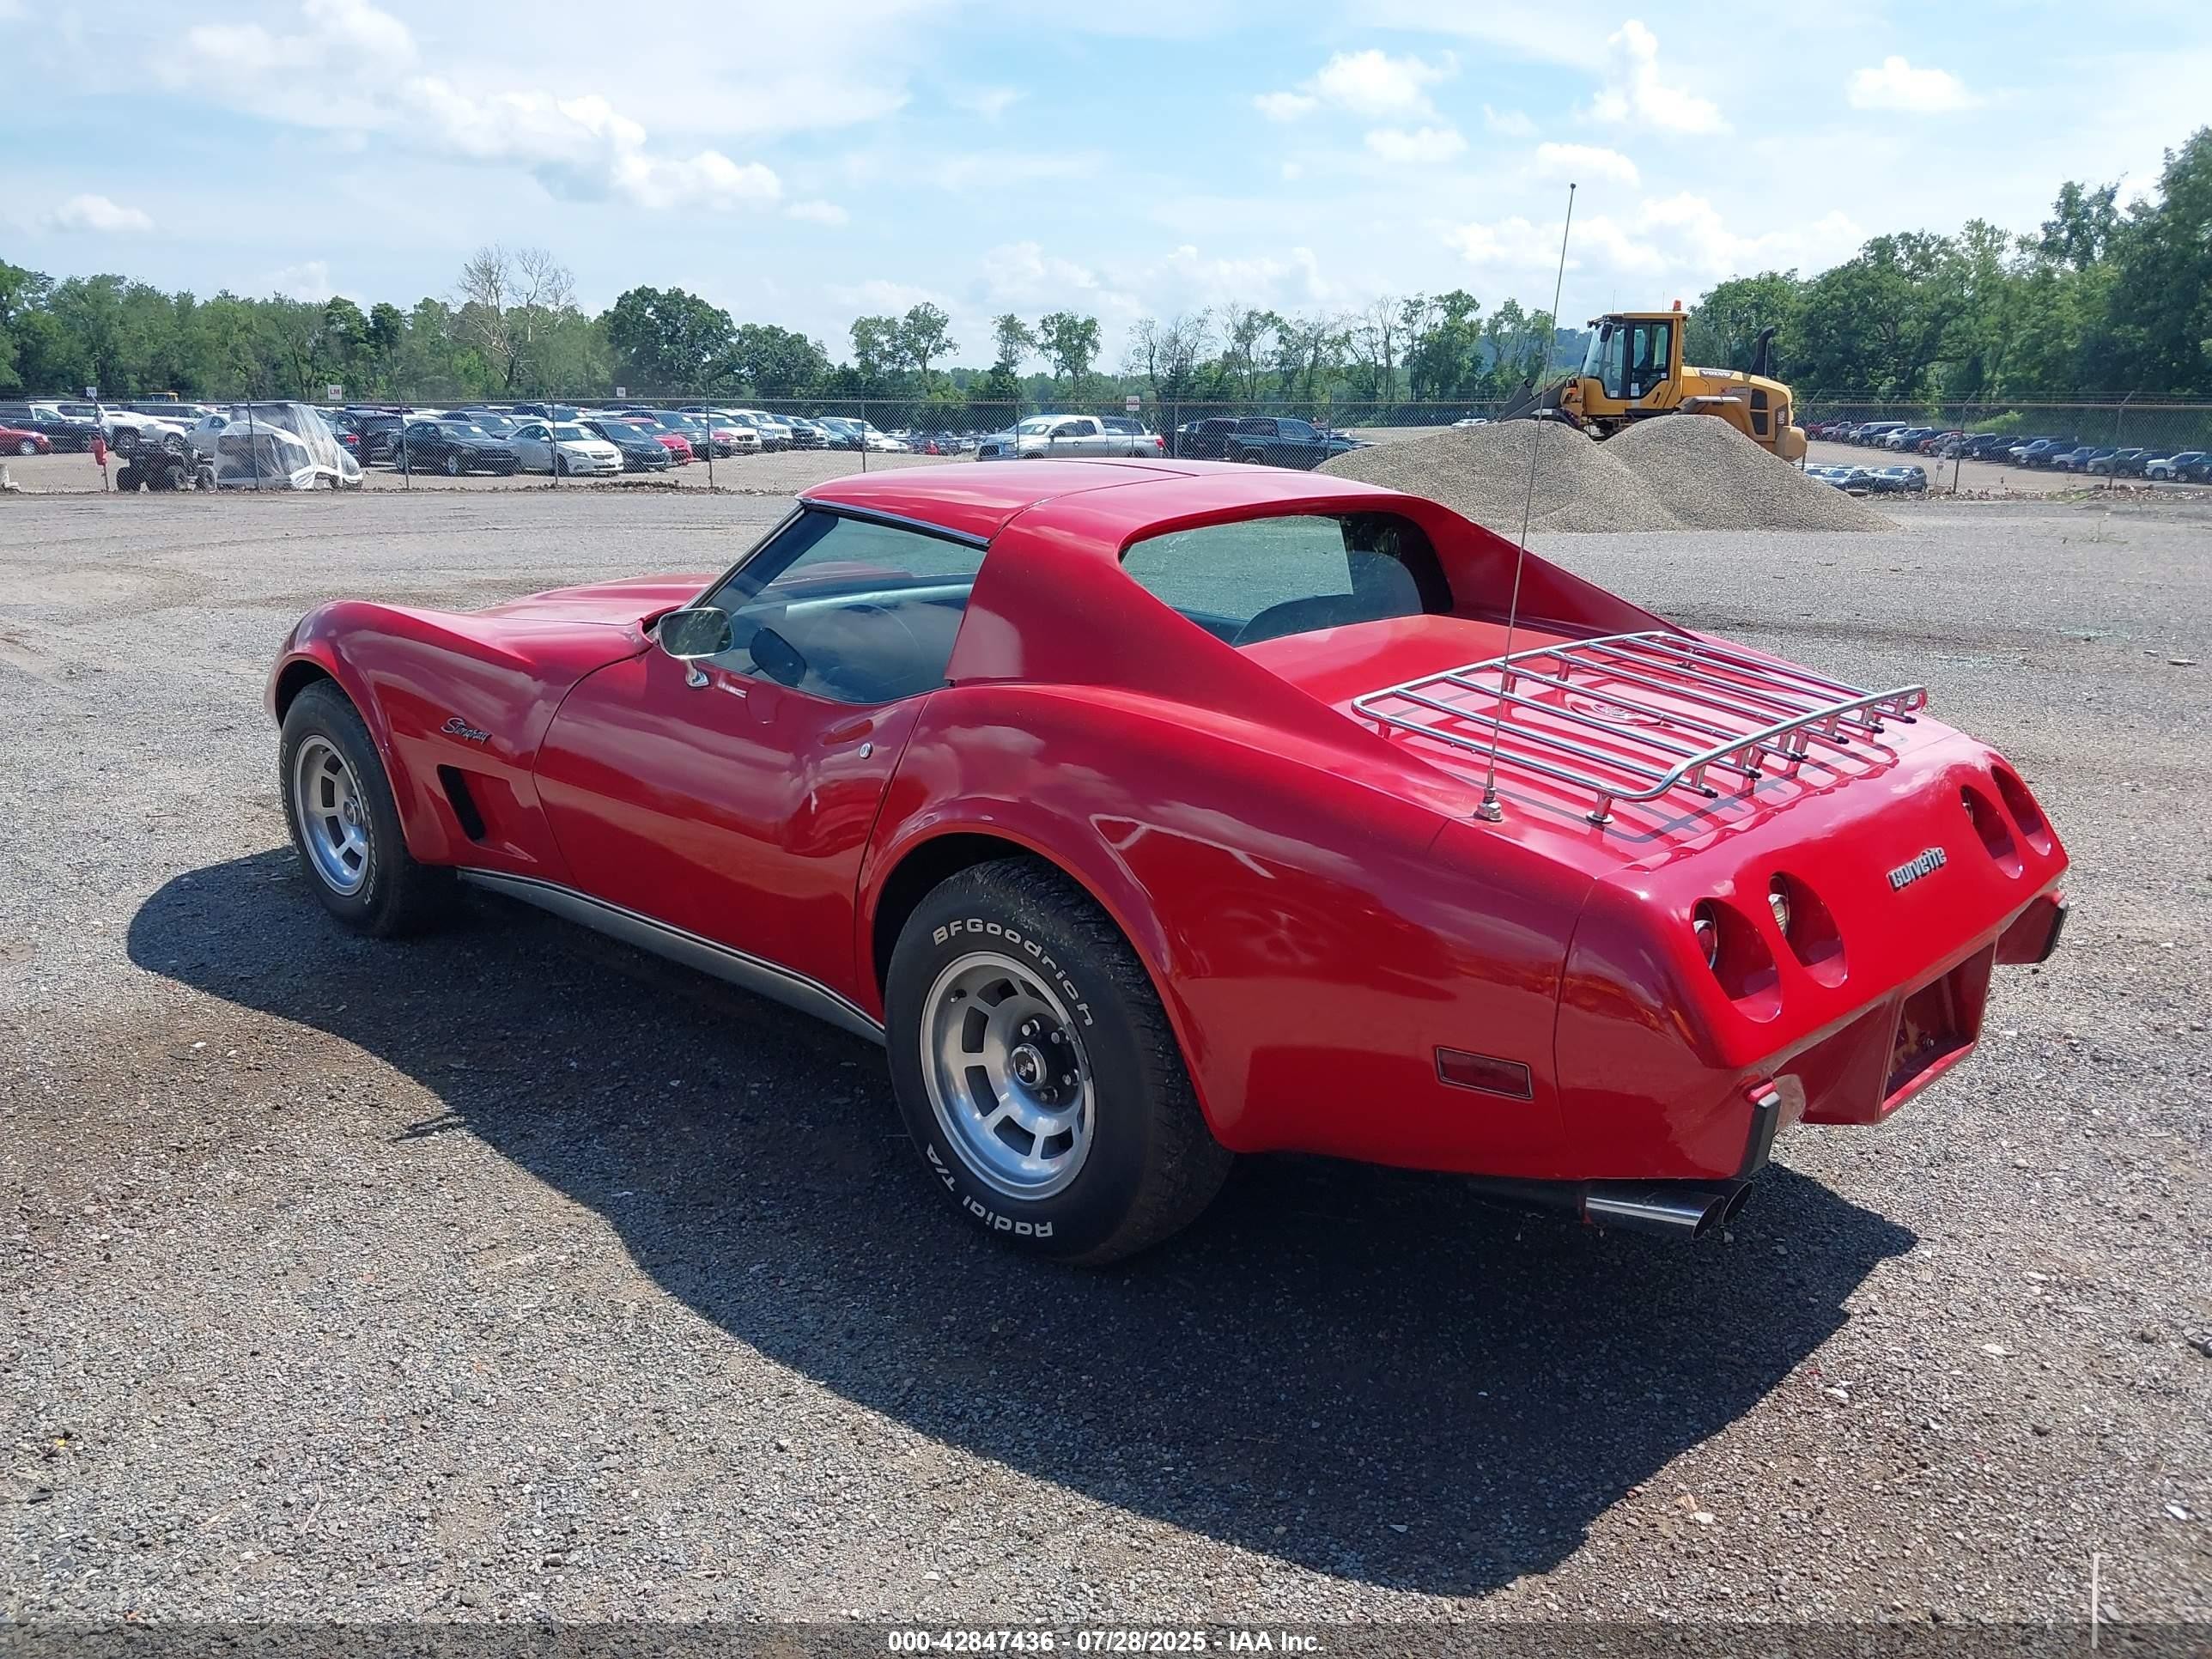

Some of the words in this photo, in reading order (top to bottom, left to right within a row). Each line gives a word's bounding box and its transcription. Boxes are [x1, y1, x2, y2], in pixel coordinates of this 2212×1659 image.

[440, 716, 493, 745] Stingray
[933, 917, 1094, 1027] BFGoodrich
[927, 1142, 957, 1192] T/A
[962, 1195, 1054, 1238] Radial
